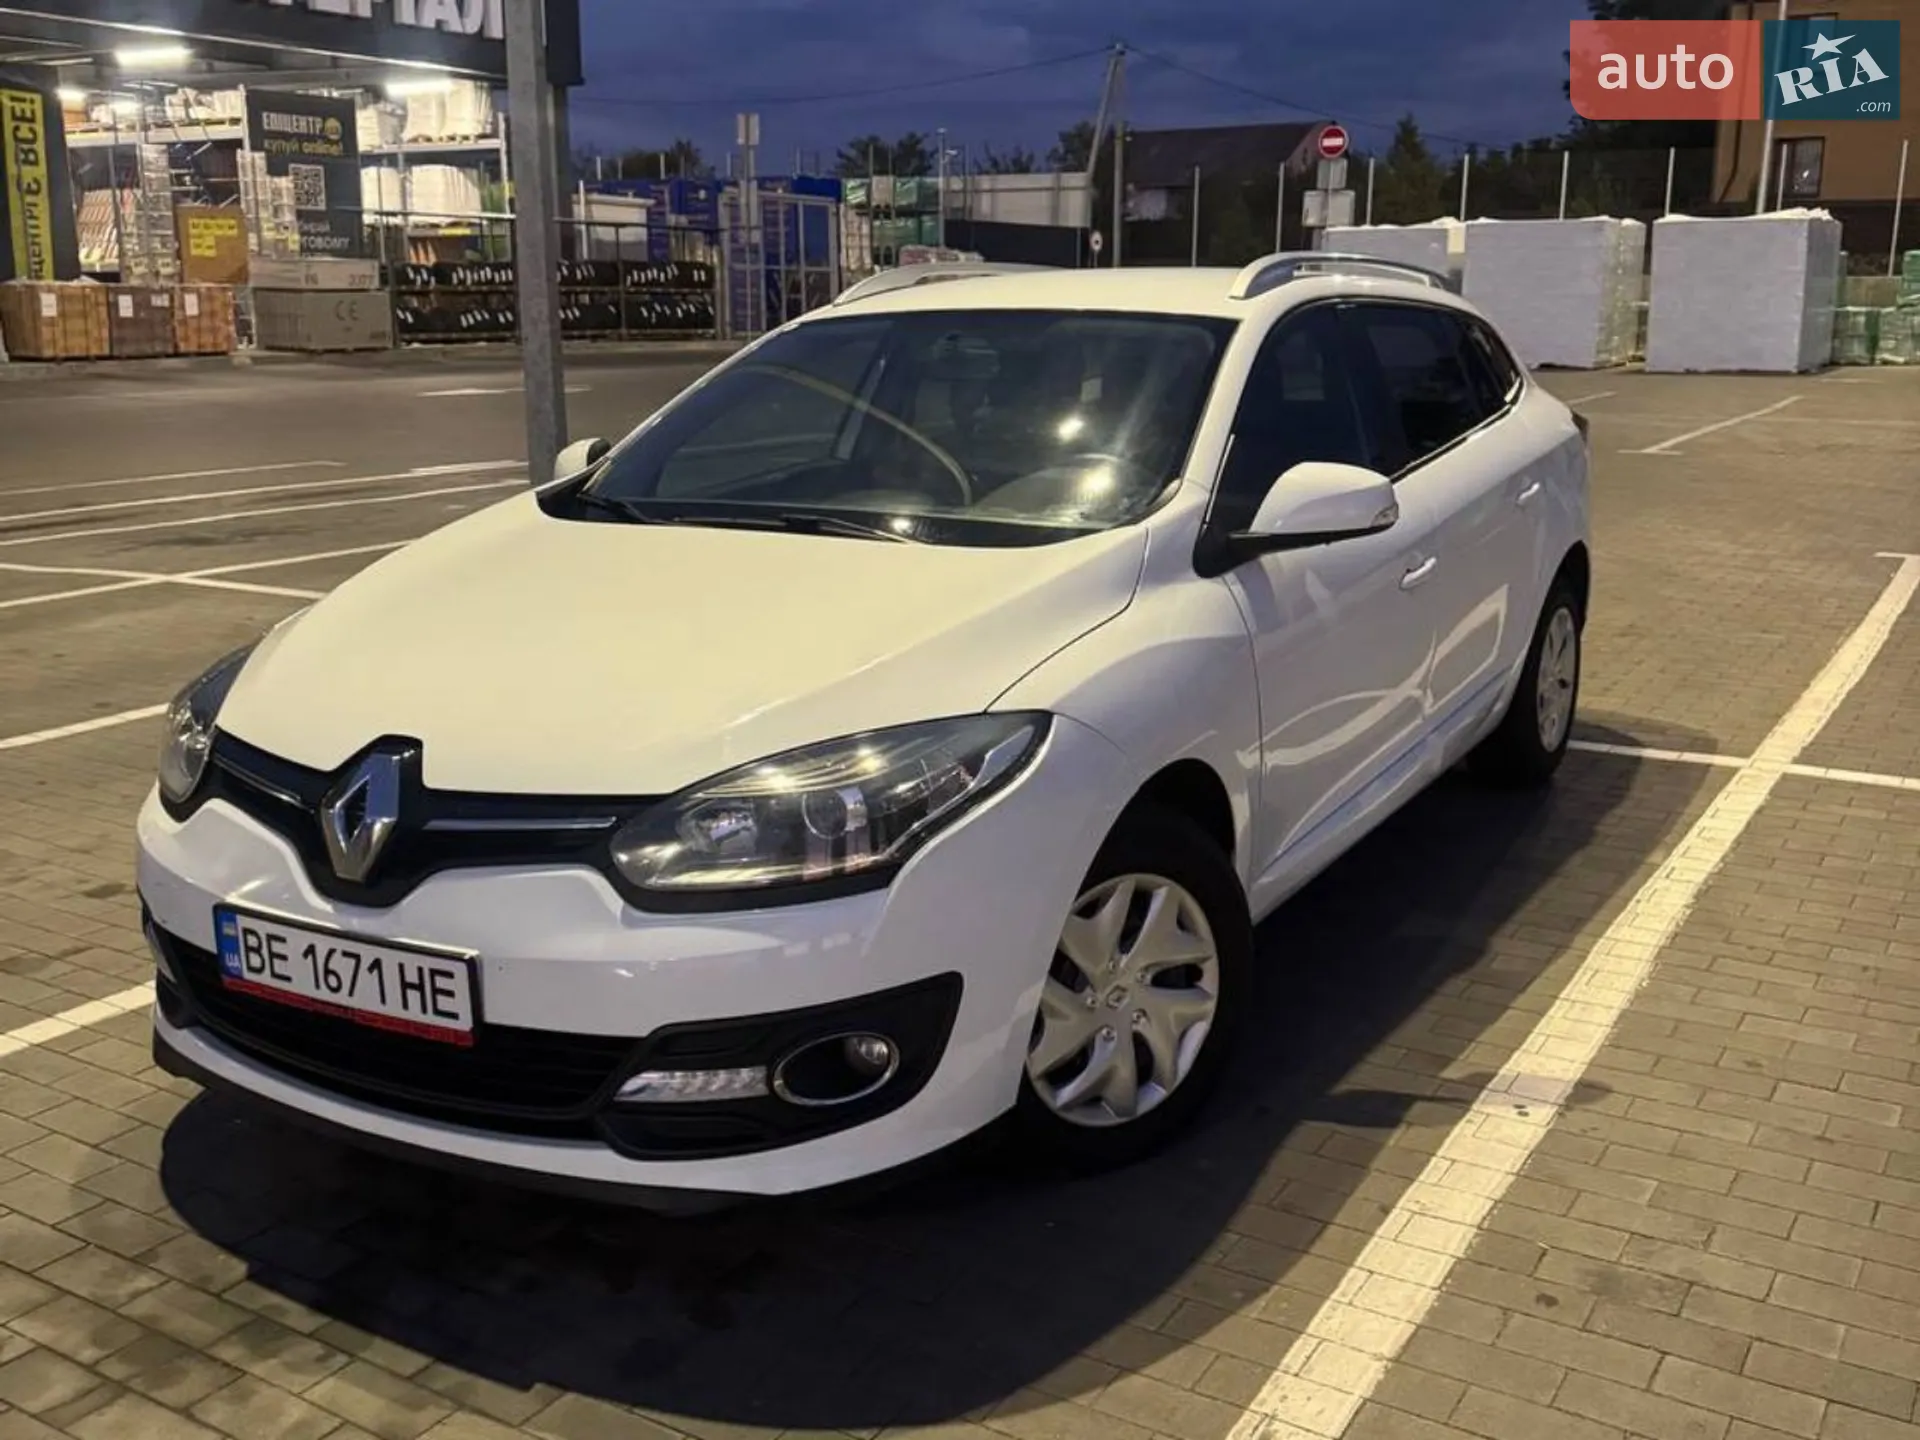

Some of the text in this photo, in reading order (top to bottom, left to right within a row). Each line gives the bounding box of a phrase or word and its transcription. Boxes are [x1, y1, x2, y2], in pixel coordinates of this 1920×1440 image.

[10, 95, 40, 167] ВСЕ!
[242, 926, 460, 1021] BE 1671 HE
